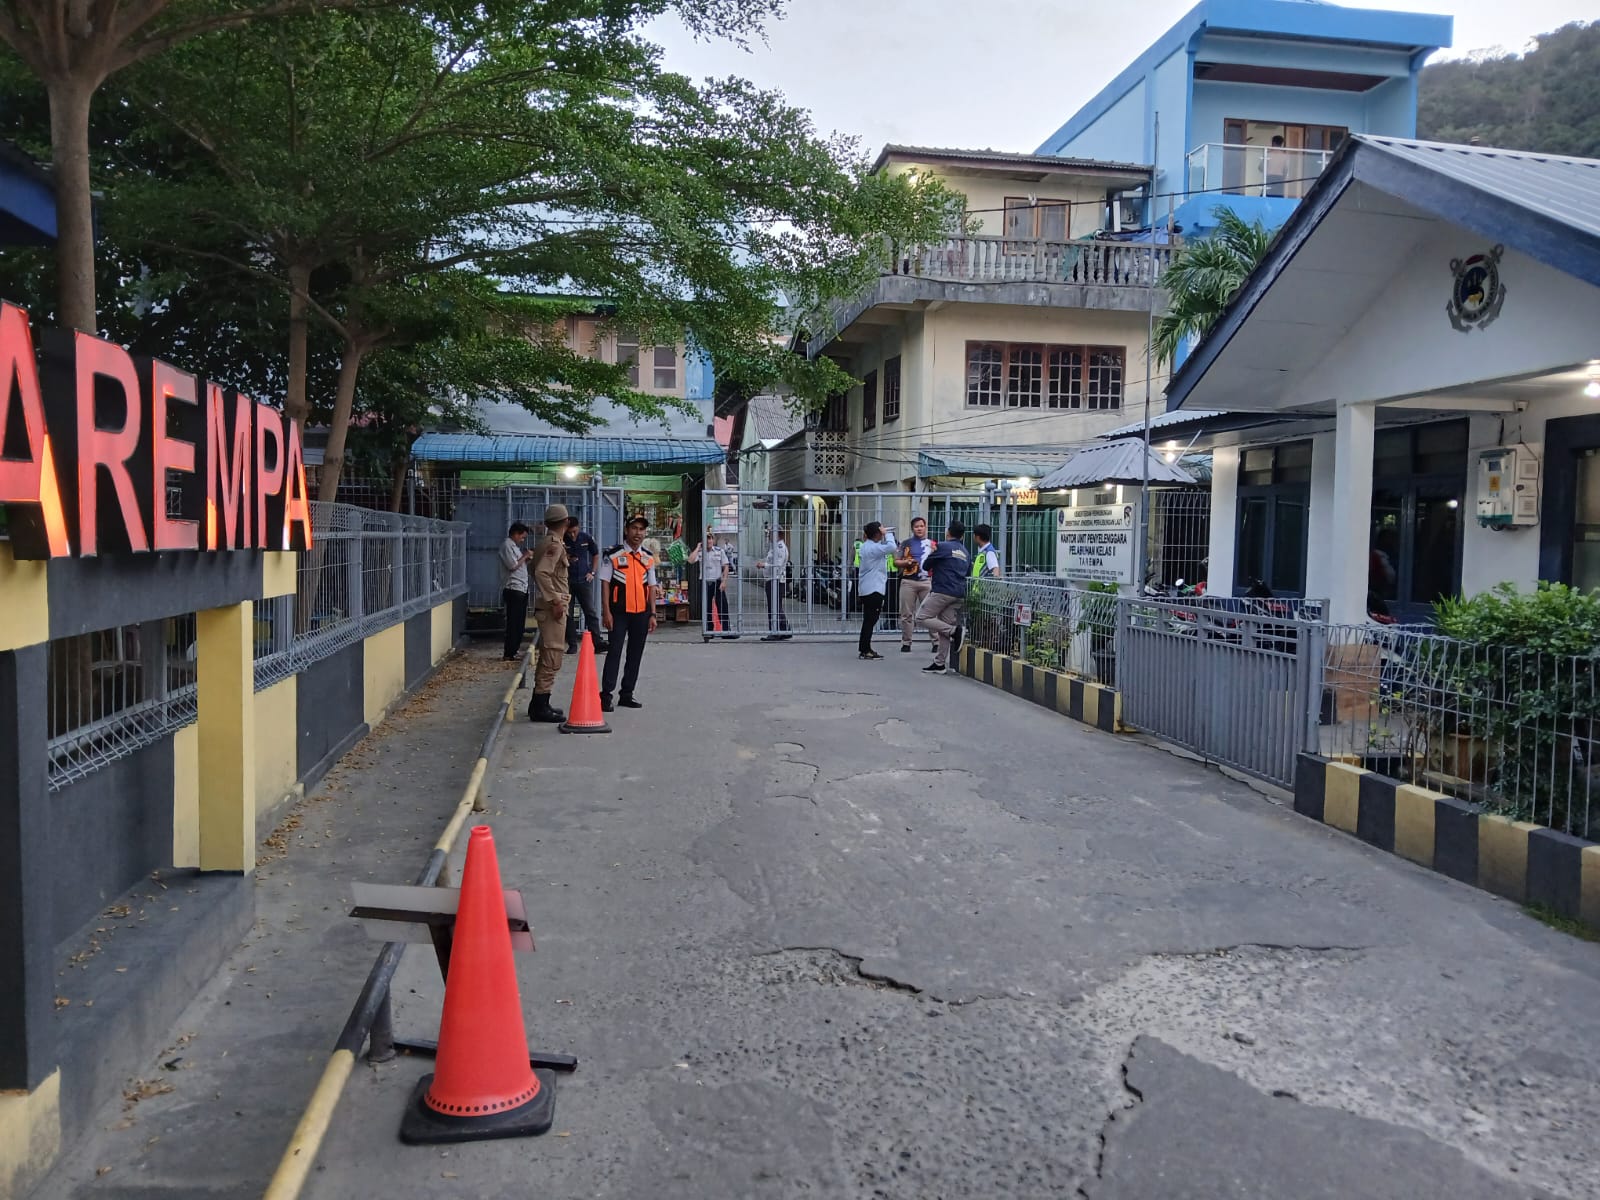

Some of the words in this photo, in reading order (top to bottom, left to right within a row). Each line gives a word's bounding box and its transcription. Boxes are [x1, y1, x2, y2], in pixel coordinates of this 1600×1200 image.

[1060, 533, 1076, 544] KANTOR
[1077, 533, 1086, 544] UNIT
[1087, 533, 1127, 545] PENYELENGGARA
[1069, 545, 1095, 556] PELABUHAN
[1096, 546, 1112, 556] KELAS
